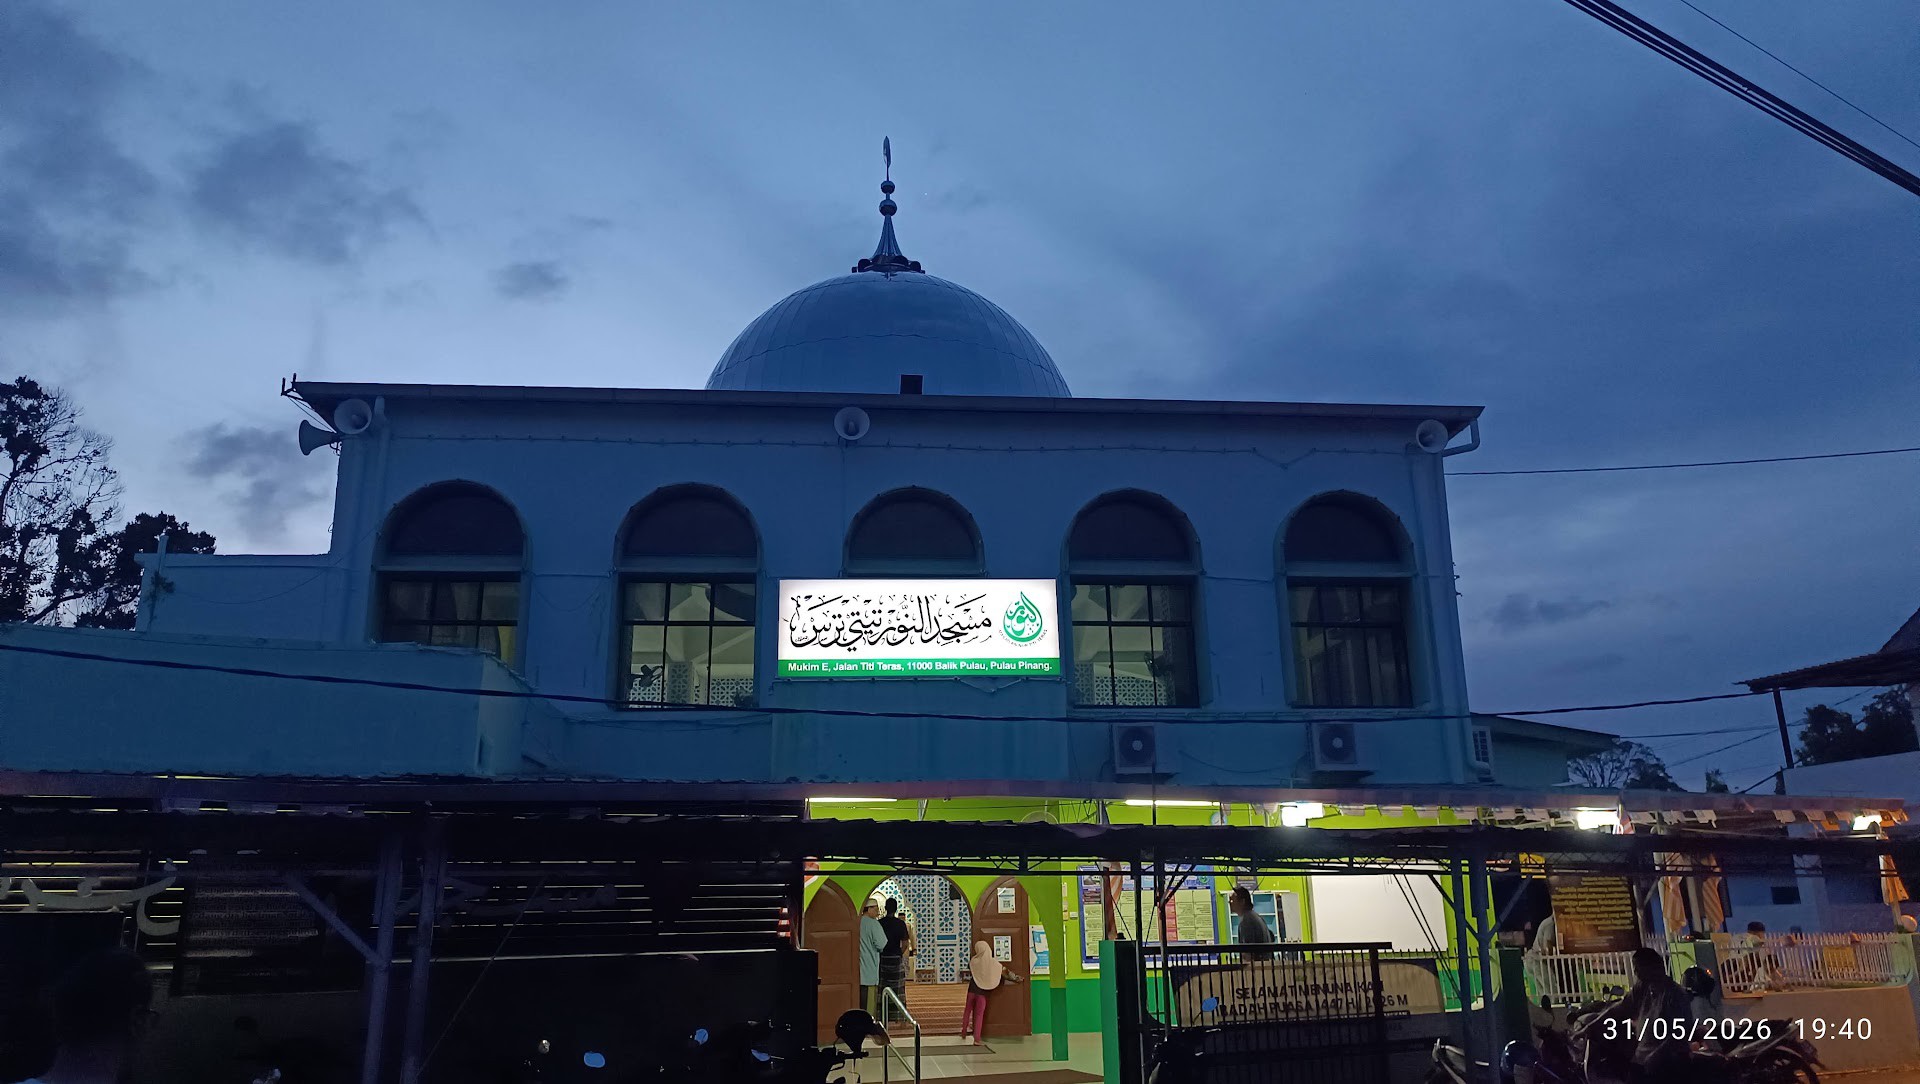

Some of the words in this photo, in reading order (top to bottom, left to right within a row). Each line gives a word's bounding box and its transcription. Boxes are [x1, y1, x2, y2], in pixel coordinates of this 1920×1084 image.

[788, 662, 819, 671] Mukim
[821, 662, 831, 673] E,
[833, 662, 858, 671] Jalan
[860, 661, 875, 671] Titi
[877, 661, 904, 672] Teras,
[907, 661, 932, 671] 11000
[935, 660, 958, 670] Balik
[960, 660, 988, 671] Pulau,
[990, 660, 1016, 670] Pulau
[1018, 660, 1053, 671] Pinang.
[1235, 984, 1296, 1000] SELAMAT
[1397, 993, 1408, 1006] M
